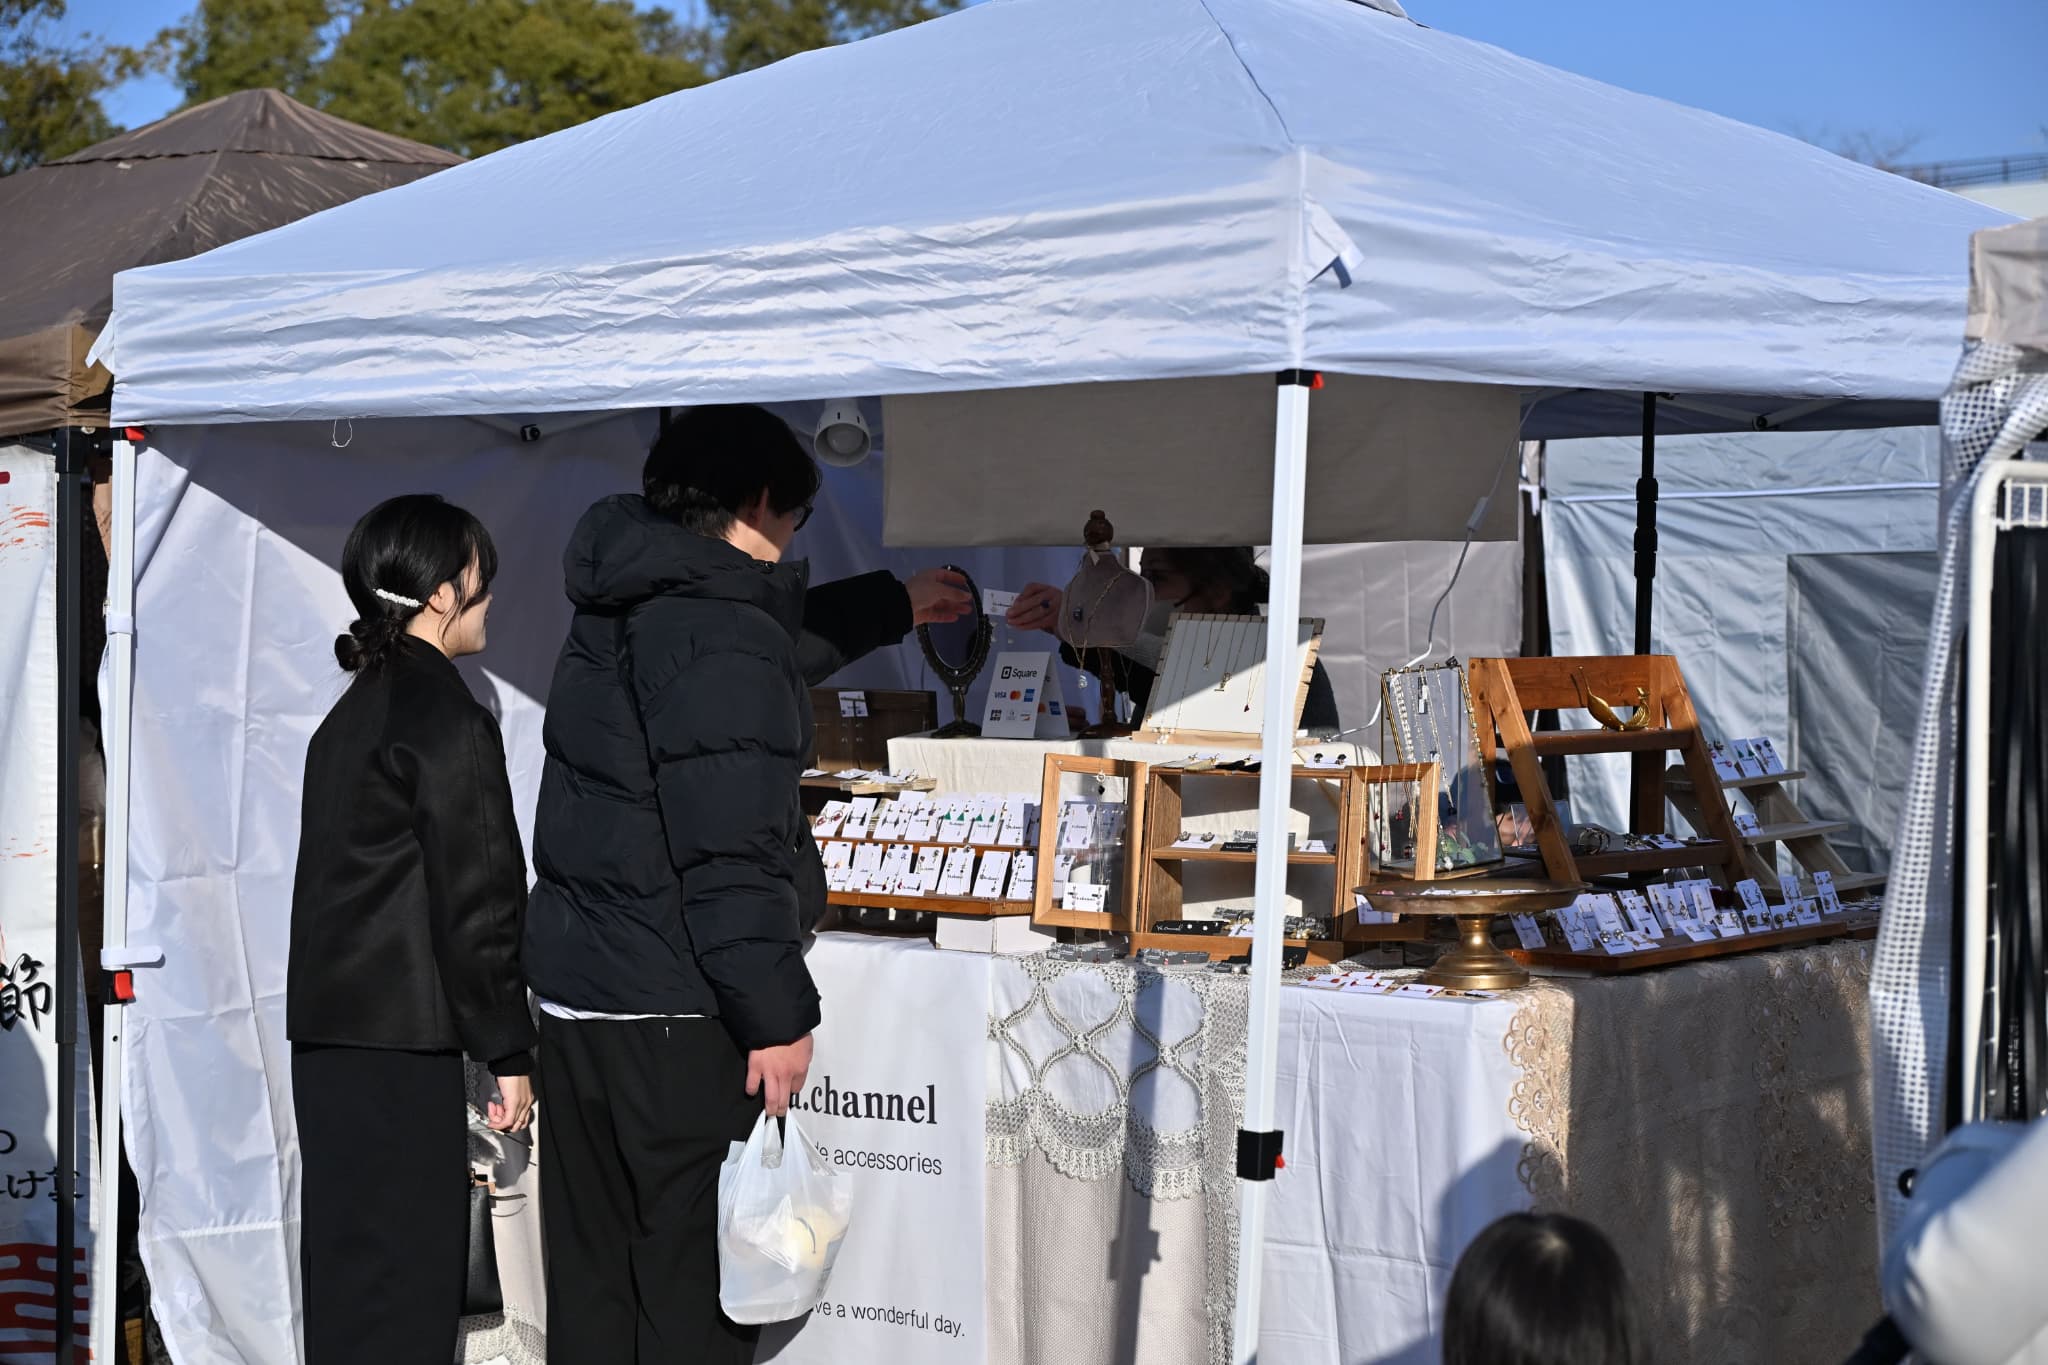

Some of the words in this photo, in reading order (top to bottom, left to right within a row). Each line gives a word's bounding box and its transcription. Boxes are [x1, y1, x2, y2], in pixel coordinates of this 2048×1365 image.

[1012, 668, 1038, 680] Square
[833, 1149, 943, 1175] accessories
[836, 1303, 846, 1318] a
[851, 1305, 929, 1330] wonderful
[934, 1315, 966, 1338] day.
